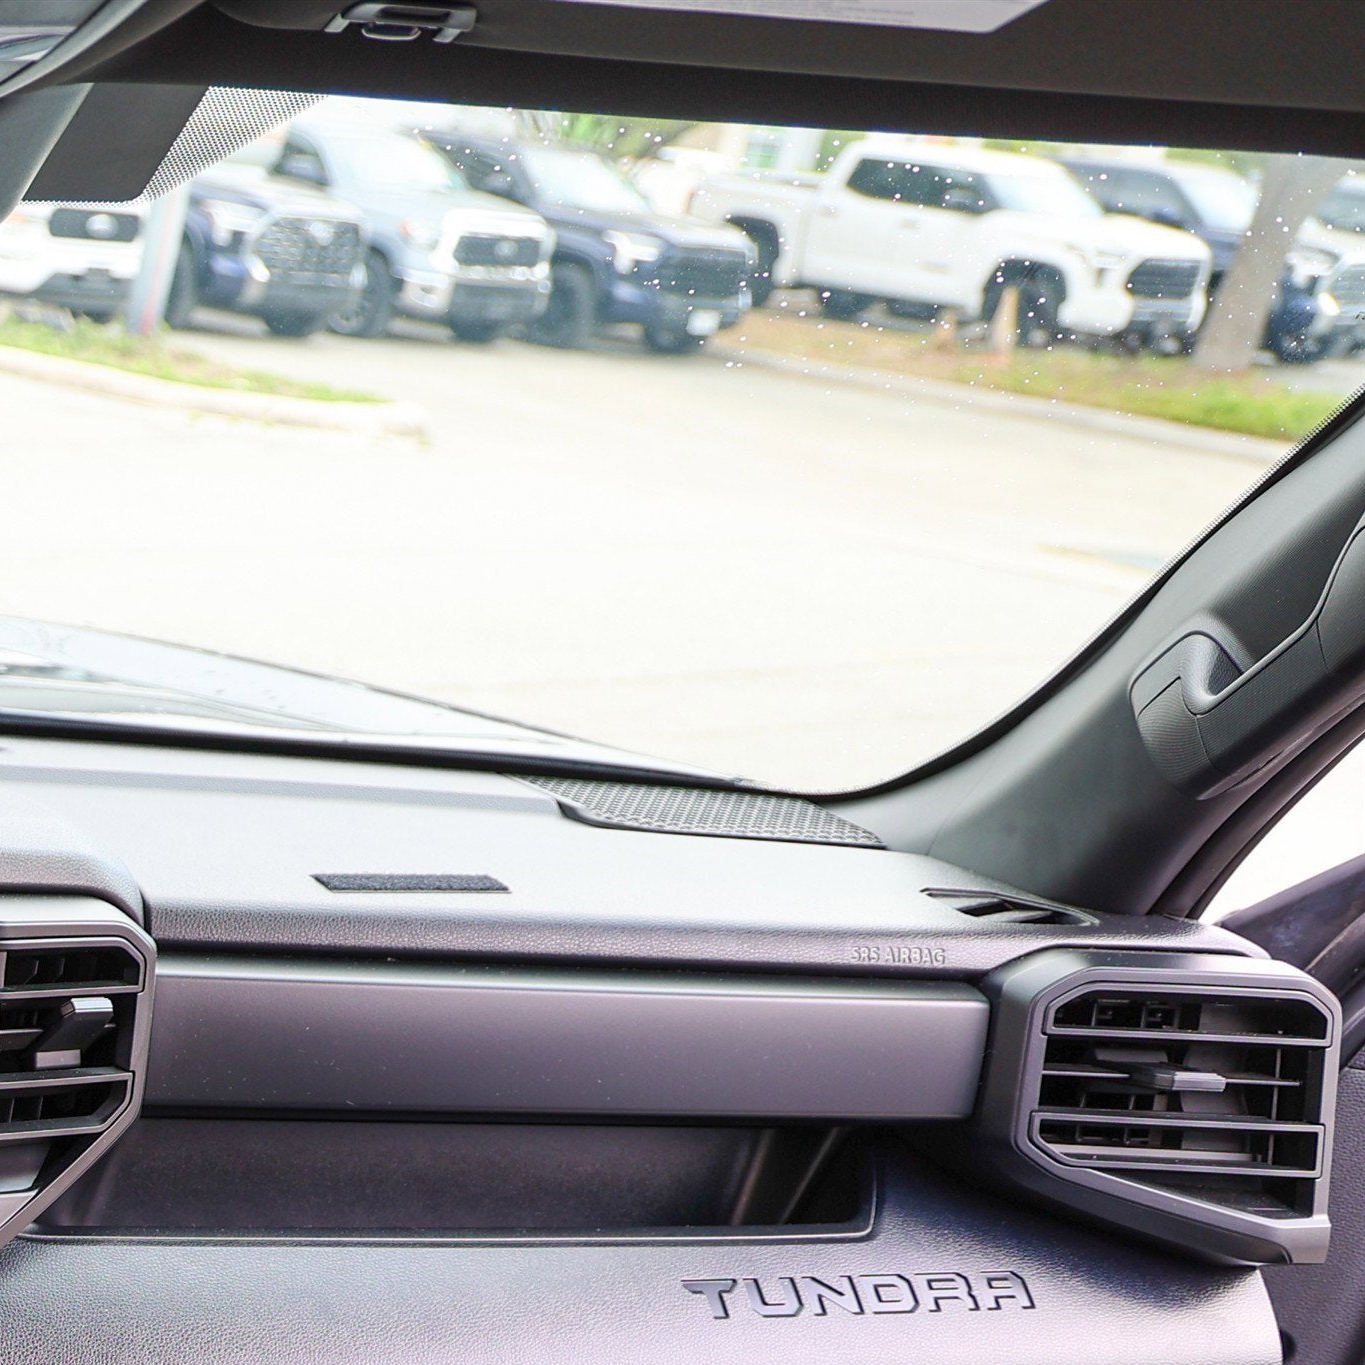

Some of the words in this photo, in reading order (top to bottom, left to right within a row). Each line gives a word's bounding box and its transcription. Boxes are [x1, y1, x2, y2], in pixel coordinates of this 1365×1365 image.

[851, 946, 881, 963] SRS
[884, 948, 946, 965] AIRBAG
[680, 1270, 1037, 1320] TUNDRA
